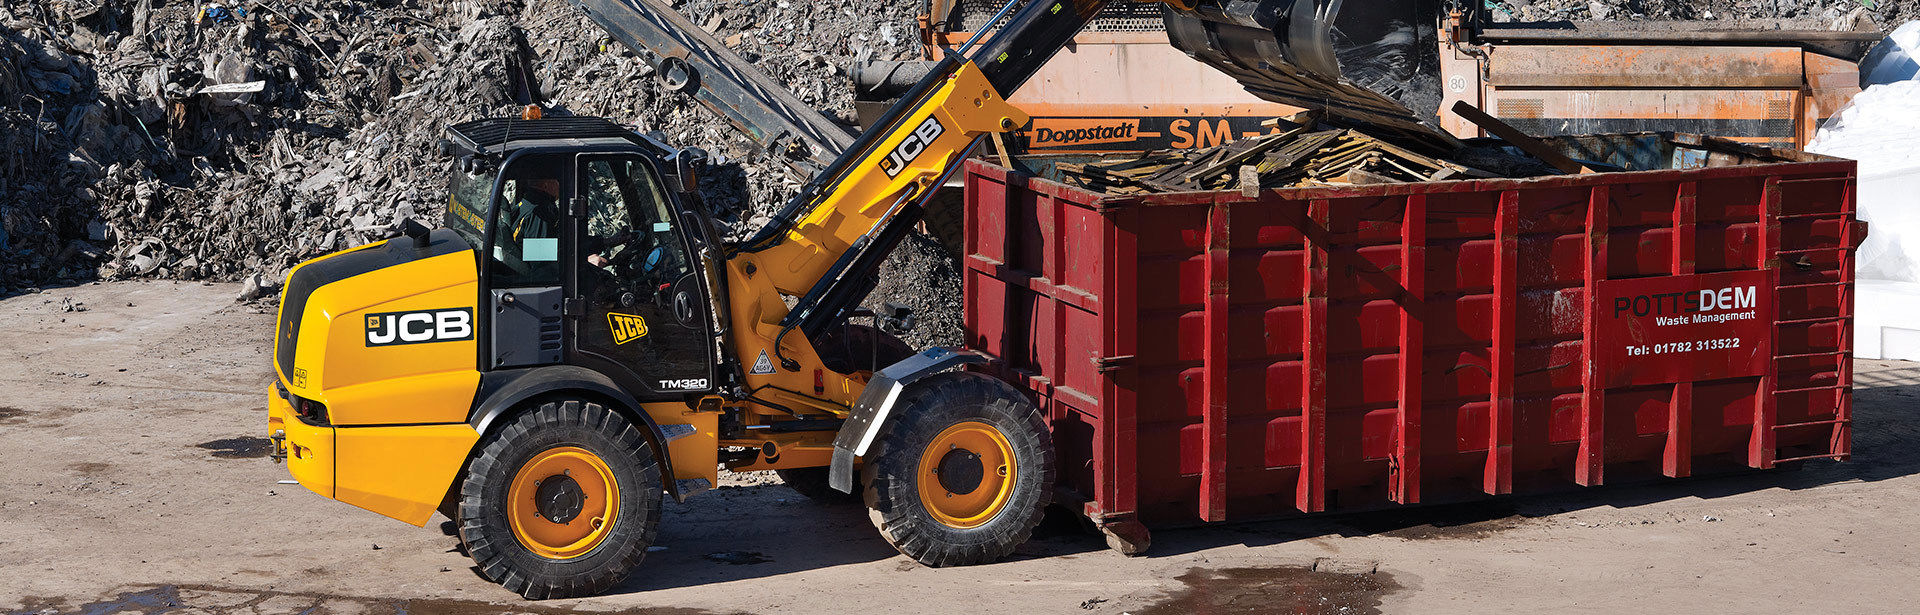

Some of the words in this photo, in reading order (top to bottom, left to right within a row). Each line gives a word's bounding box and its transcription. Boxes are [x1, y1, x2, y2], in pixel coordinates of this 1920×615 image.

[1450, 78, 1465, 90] 80
[887, 117, 942, 177] JCB
[1035, 122, 1134, 144] Doppstadt
[1170, 119, 1234, 149] SM
[1614, 286, 1756, 319] POTTSDEM
[368, 310, 472, 344] JCB
[614, 315, 645, 341] JCB
[1656, 316, 1689, 326] Waste
[1692, 310, 1756, 324] Management
[1626, 346, 1650, 356] Tel:
[1654, 341, 1692, 354] 01782
[1696, 338, 1740, 351] 313522
[659, 379, 708, 389] TM320
